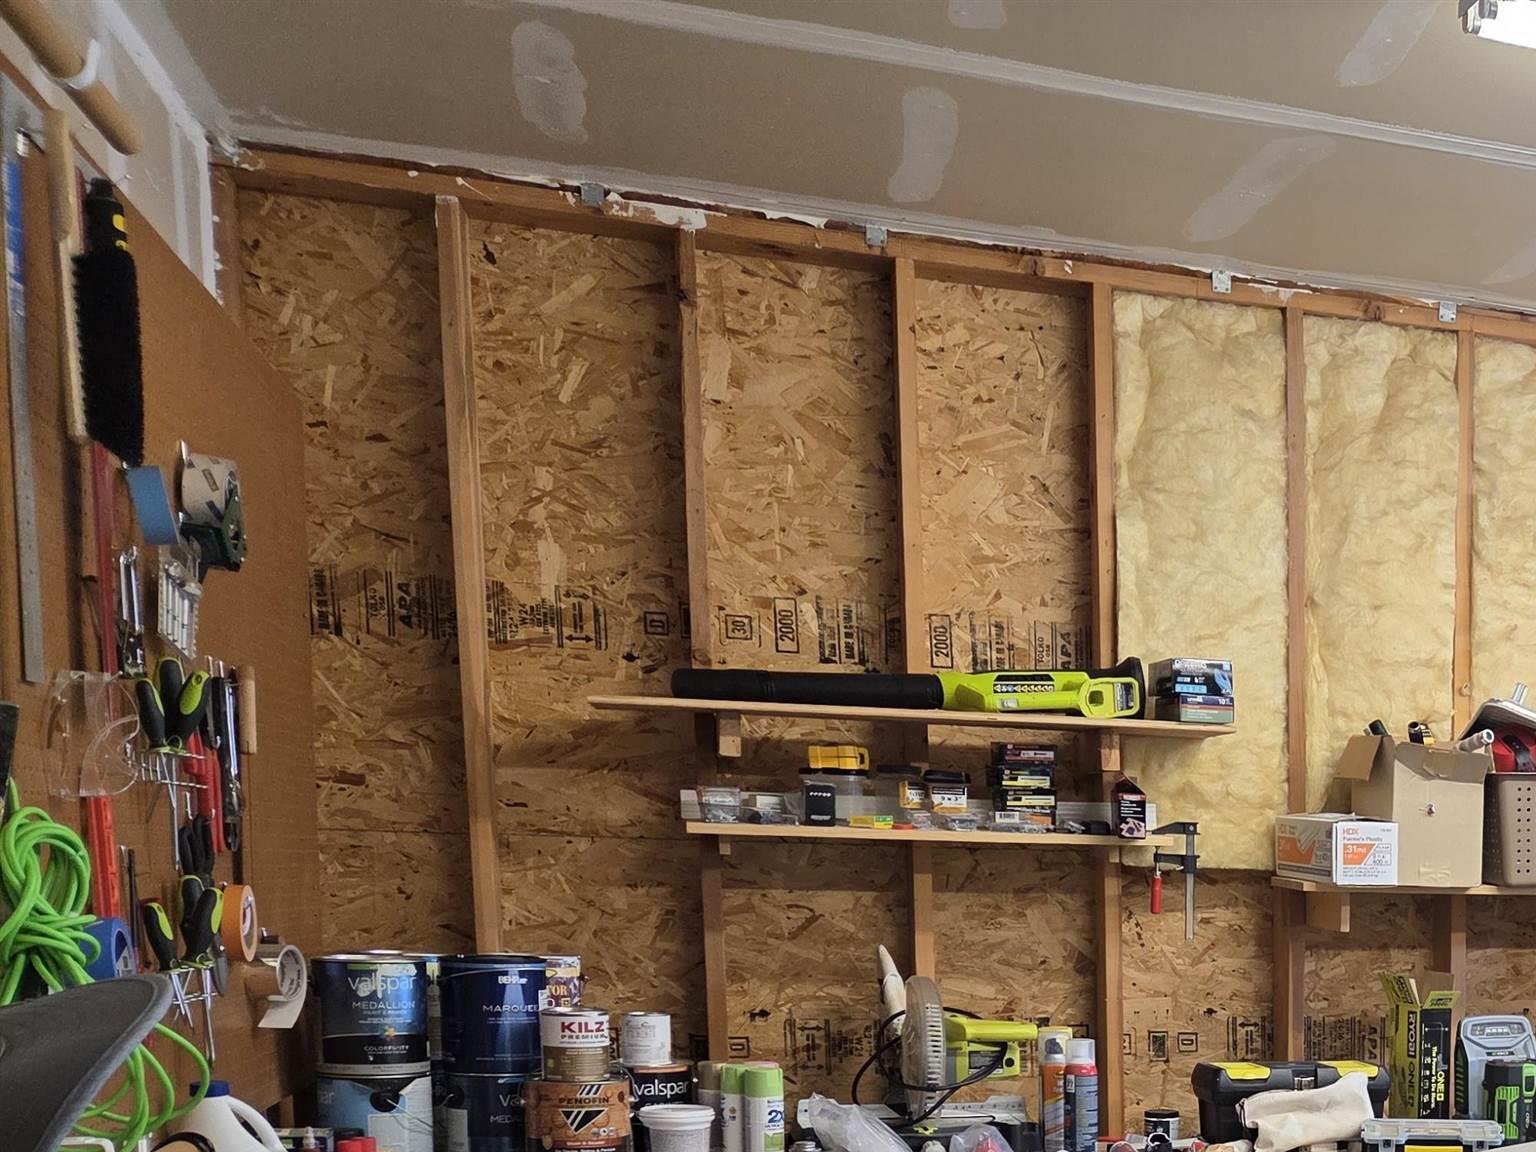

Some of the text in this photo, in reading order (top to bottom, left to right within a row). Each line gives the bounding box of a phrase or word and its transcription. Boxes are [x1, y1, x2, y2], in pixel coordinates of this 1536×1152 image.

[397, 582, 413, 630] APA
[779, 609, 796, 643] 2000
[935, 625, 950, 658] 2000
[1060, 632, 1072, 670] APA
[352, 1001, 416, 1010] MEDALLION
[560, 1021, 605, 1033] KILZ
[1368, 1025, 1378, 1061] APA
[1408, 1013, 1416, 1057] RYOBI
[559, 1096, 609, 1105] PENOFIN
[634, 1079, 689, 1100] valspar
